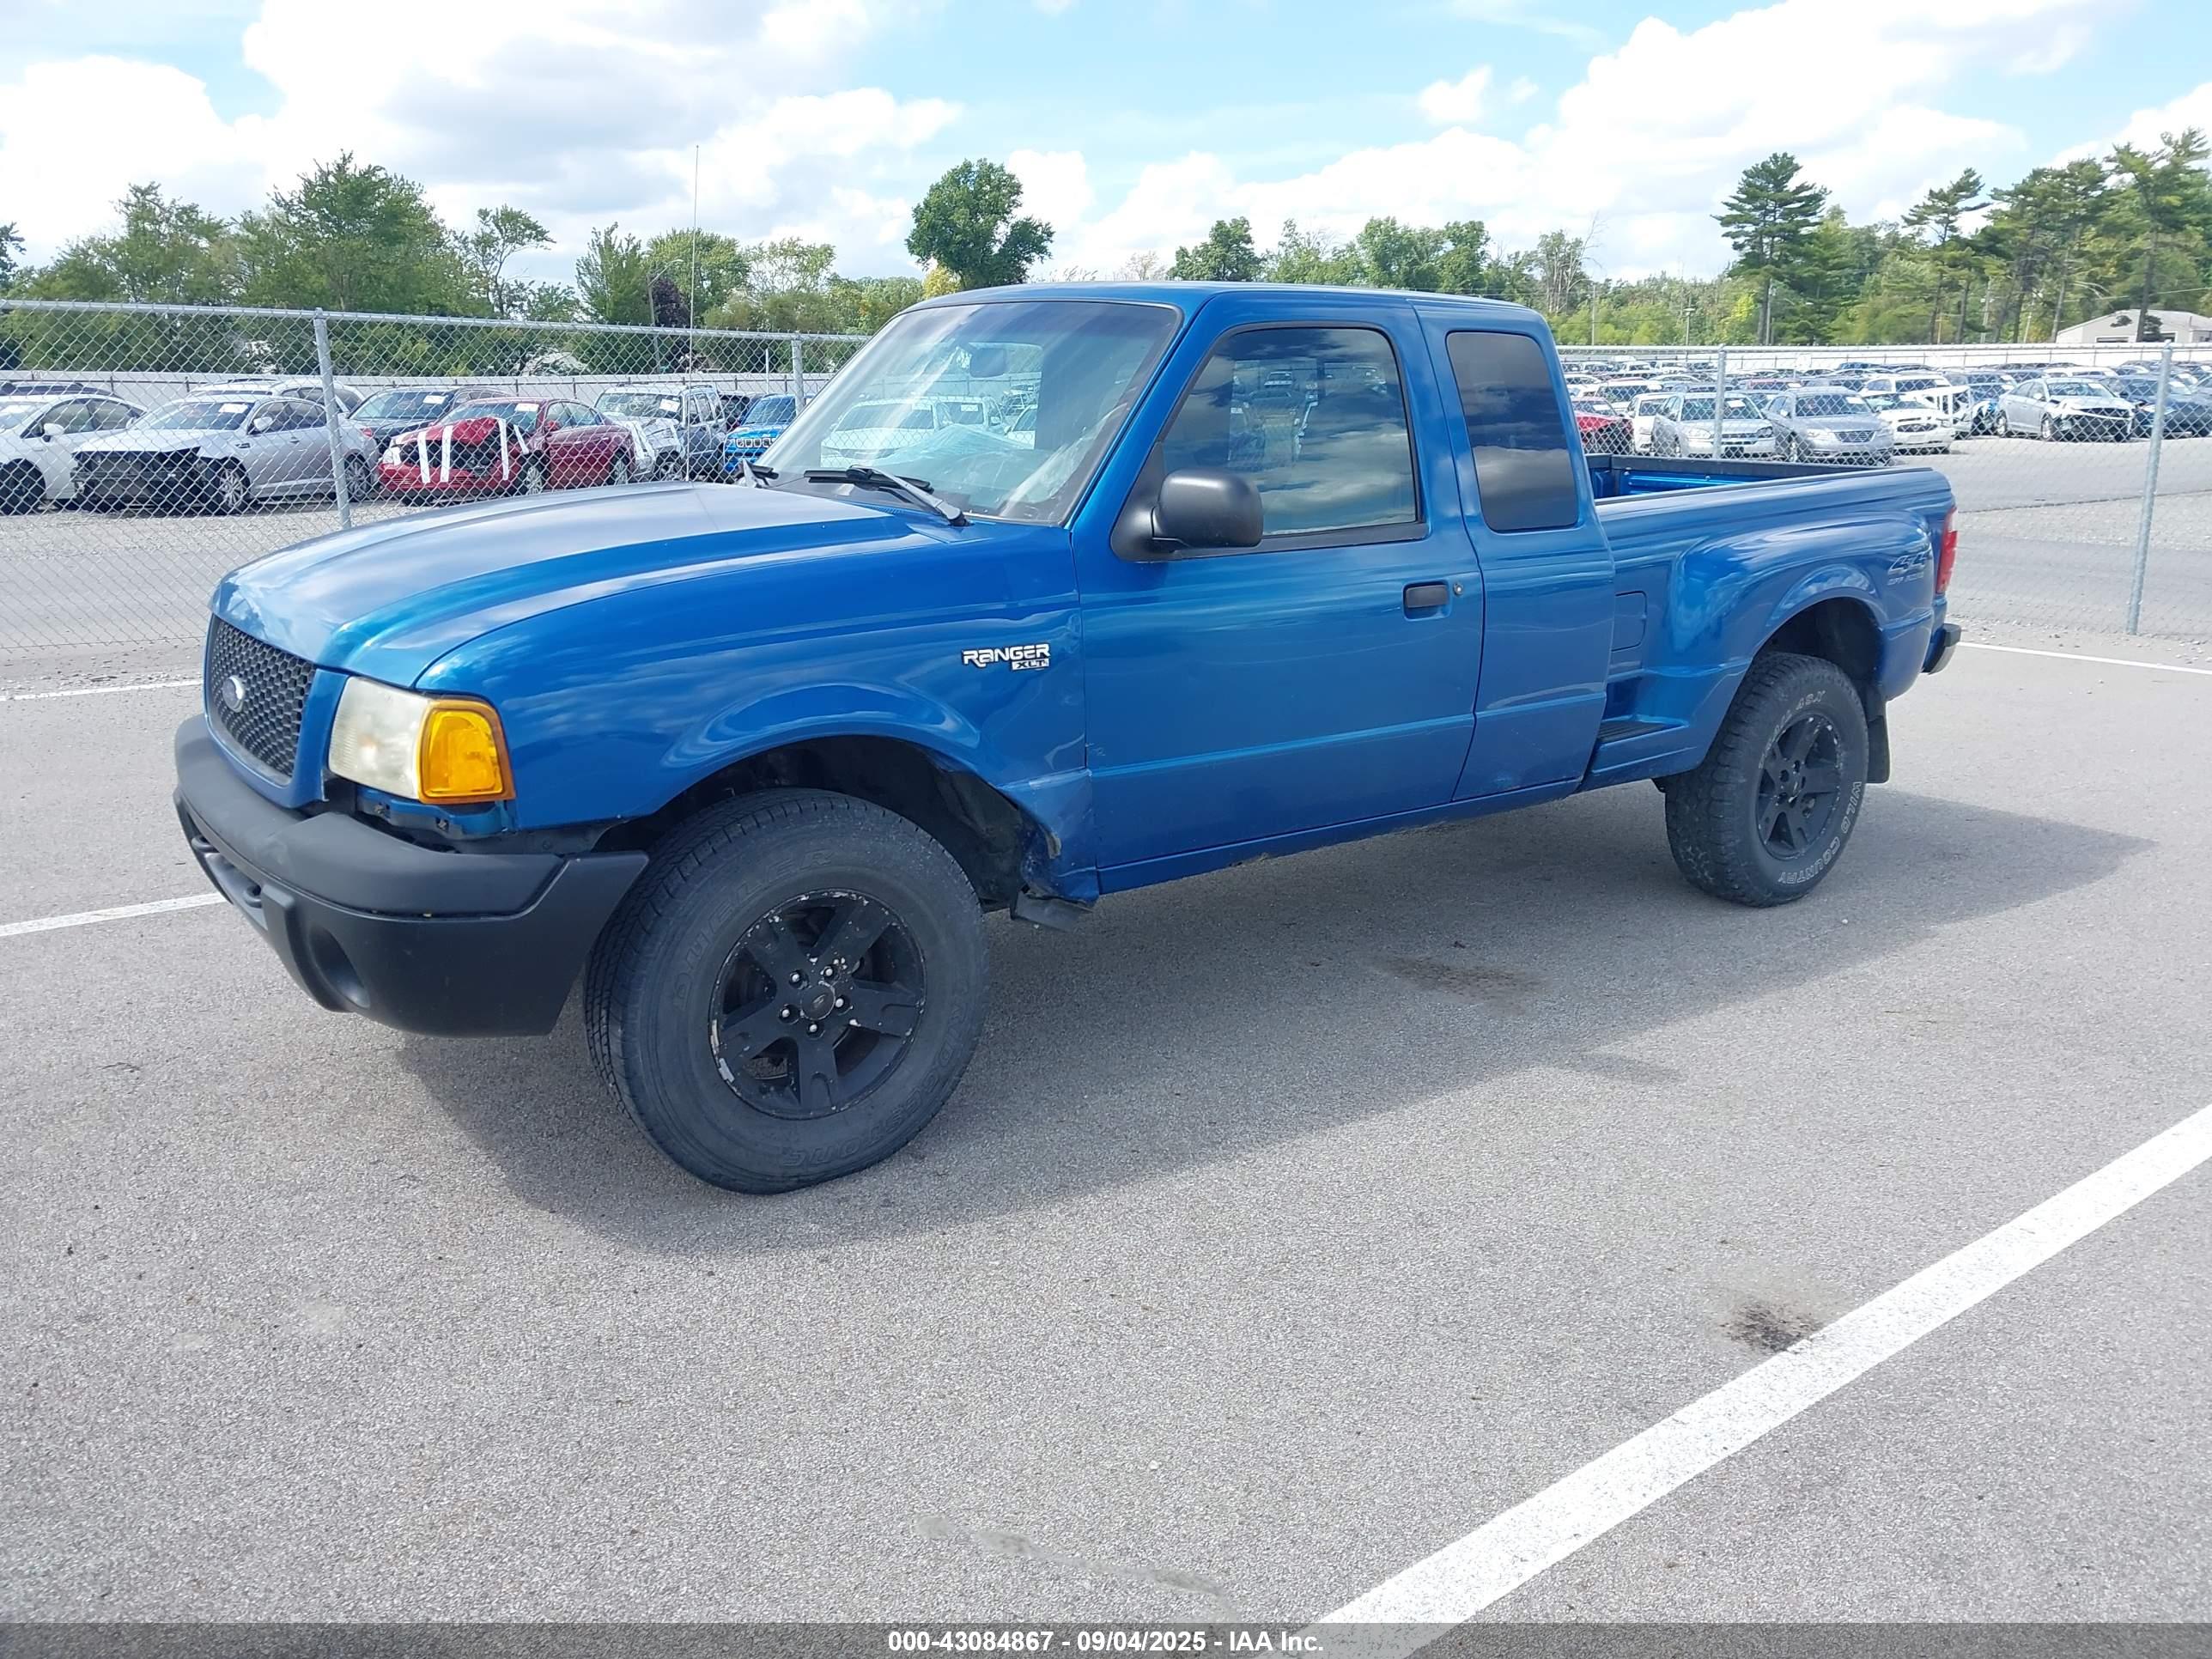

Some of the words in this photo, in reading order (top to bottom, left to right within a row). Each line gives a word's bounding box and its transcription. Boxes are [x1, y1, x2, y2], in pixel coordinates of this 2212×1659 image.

[963, 643, 1050, 668] RANGER
[1015, 659, 1048, 669] XLT
[1841, 781, 1863, 834] WILD
[1778, 836, 1842, 884] COUNTRY
